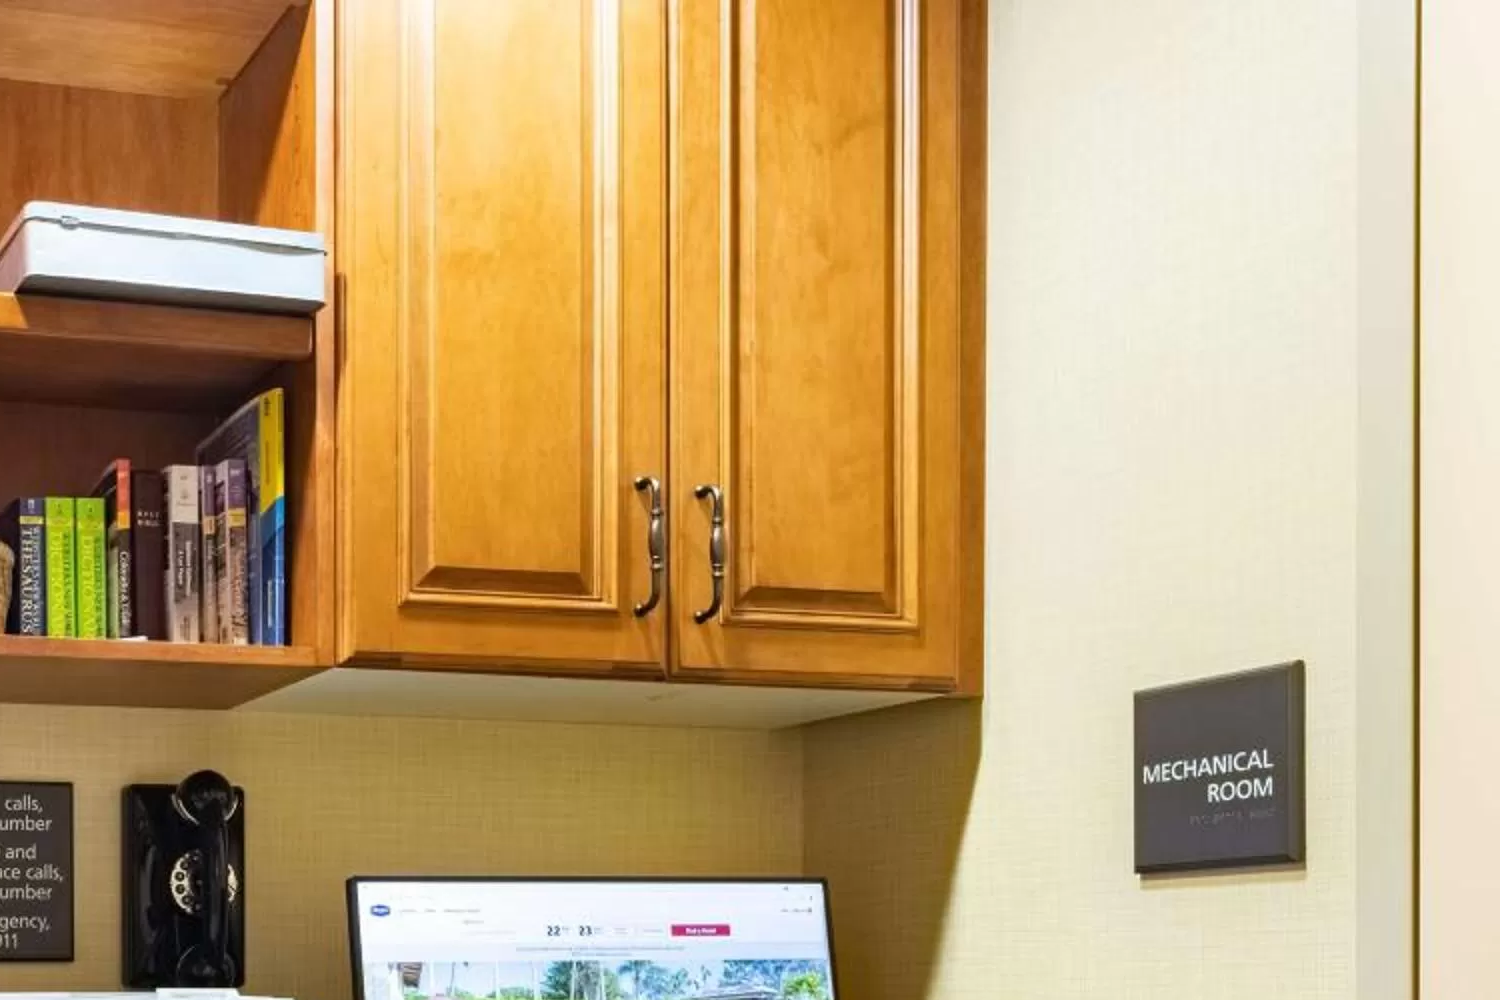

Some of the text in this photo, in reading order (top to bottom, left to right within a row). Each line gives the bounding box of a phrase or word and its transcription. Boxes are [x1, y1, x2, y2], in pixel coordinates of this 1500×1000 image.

[21, 527, 33, 633] THESAURUS
[51, 531, 63, 637] DICTIONAR
[82, 535, 95, 638] DICTIONAR
[120, 551, 130, 593] Colorado
[1143, 748, 1274, 784] MECHANICAL
[5, 795, 43, 812] calls,
[1207, 776, 1273, 802] ROOM
[5, 844, 36, 859] and
[26, 865, 63, 882] calls,
[547, 925, 561, 936] 22
